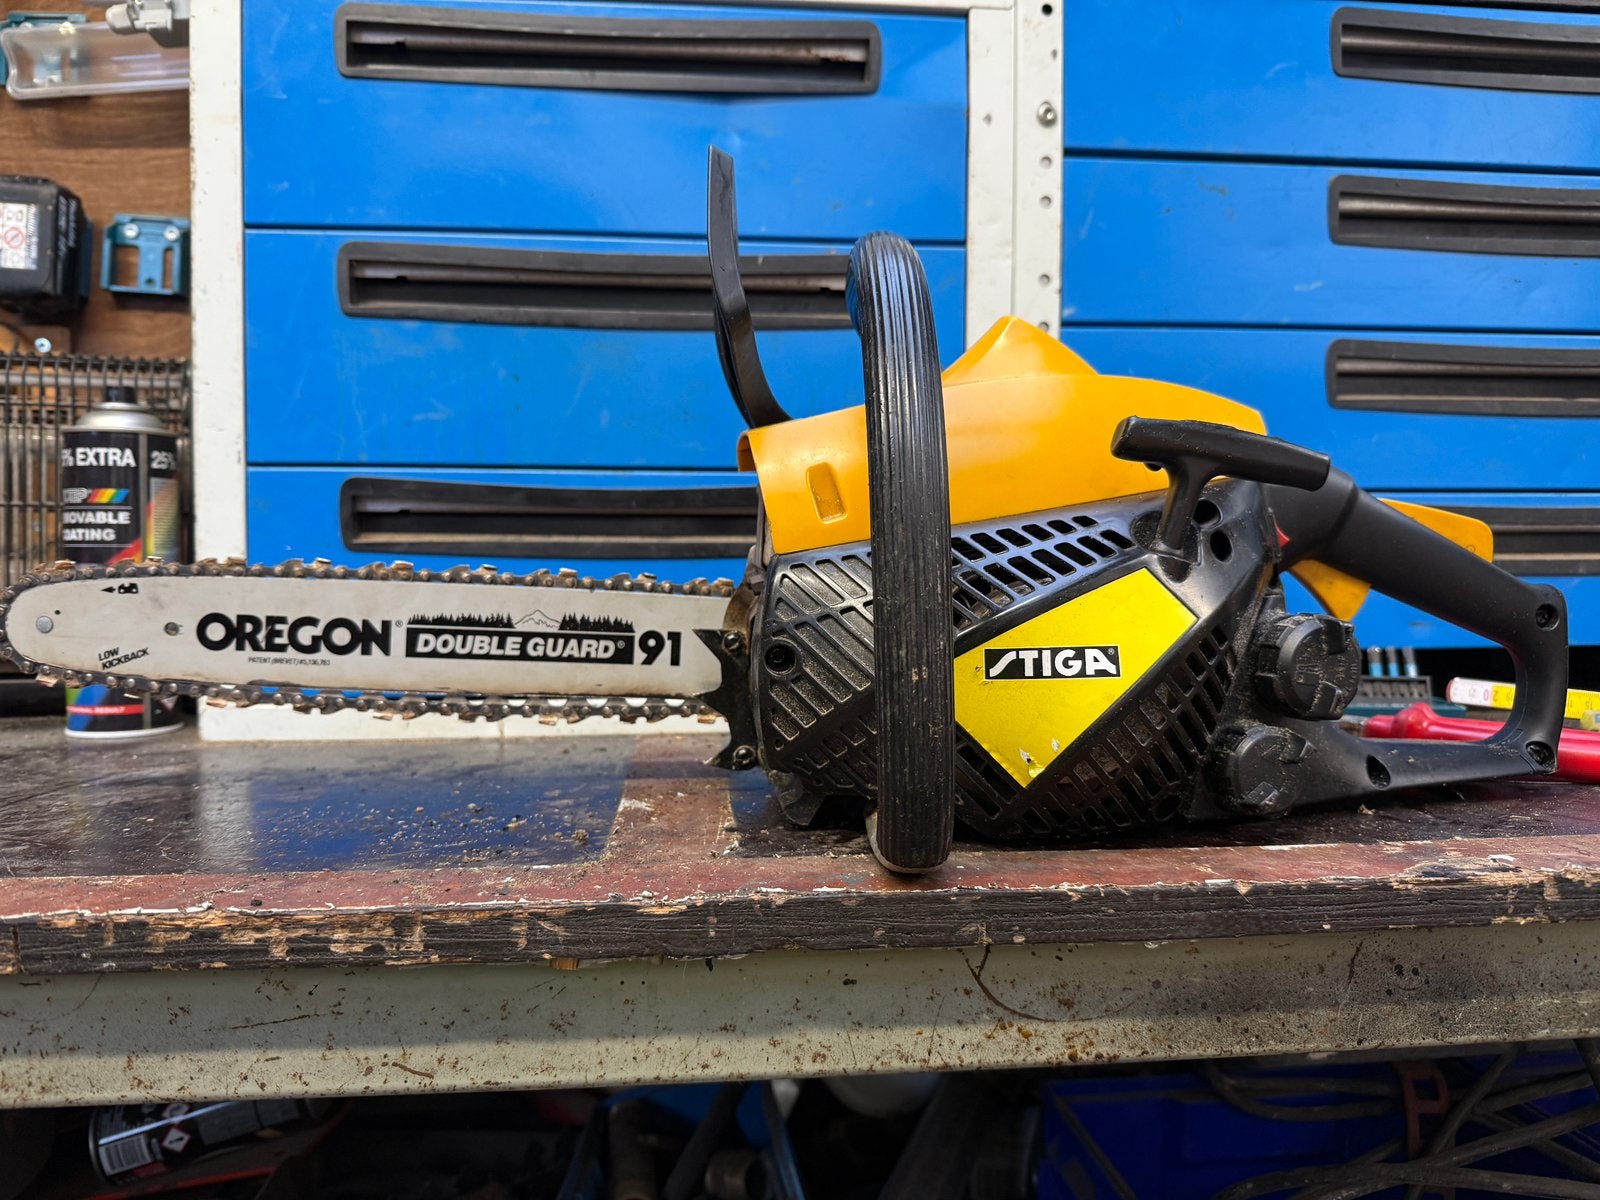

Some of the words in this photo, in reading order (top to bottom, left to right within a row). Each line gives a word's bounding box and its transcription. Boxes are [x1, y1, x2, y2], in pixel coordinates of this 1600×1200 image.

[75, 448, 136, 467] EXTRA
[98, 647, 119, 661] LOW
[417, 633, 522, 656] DOUBLE
[638, 630, 681, 666] 91
[102, 647, 149, 670] KICKBACK
